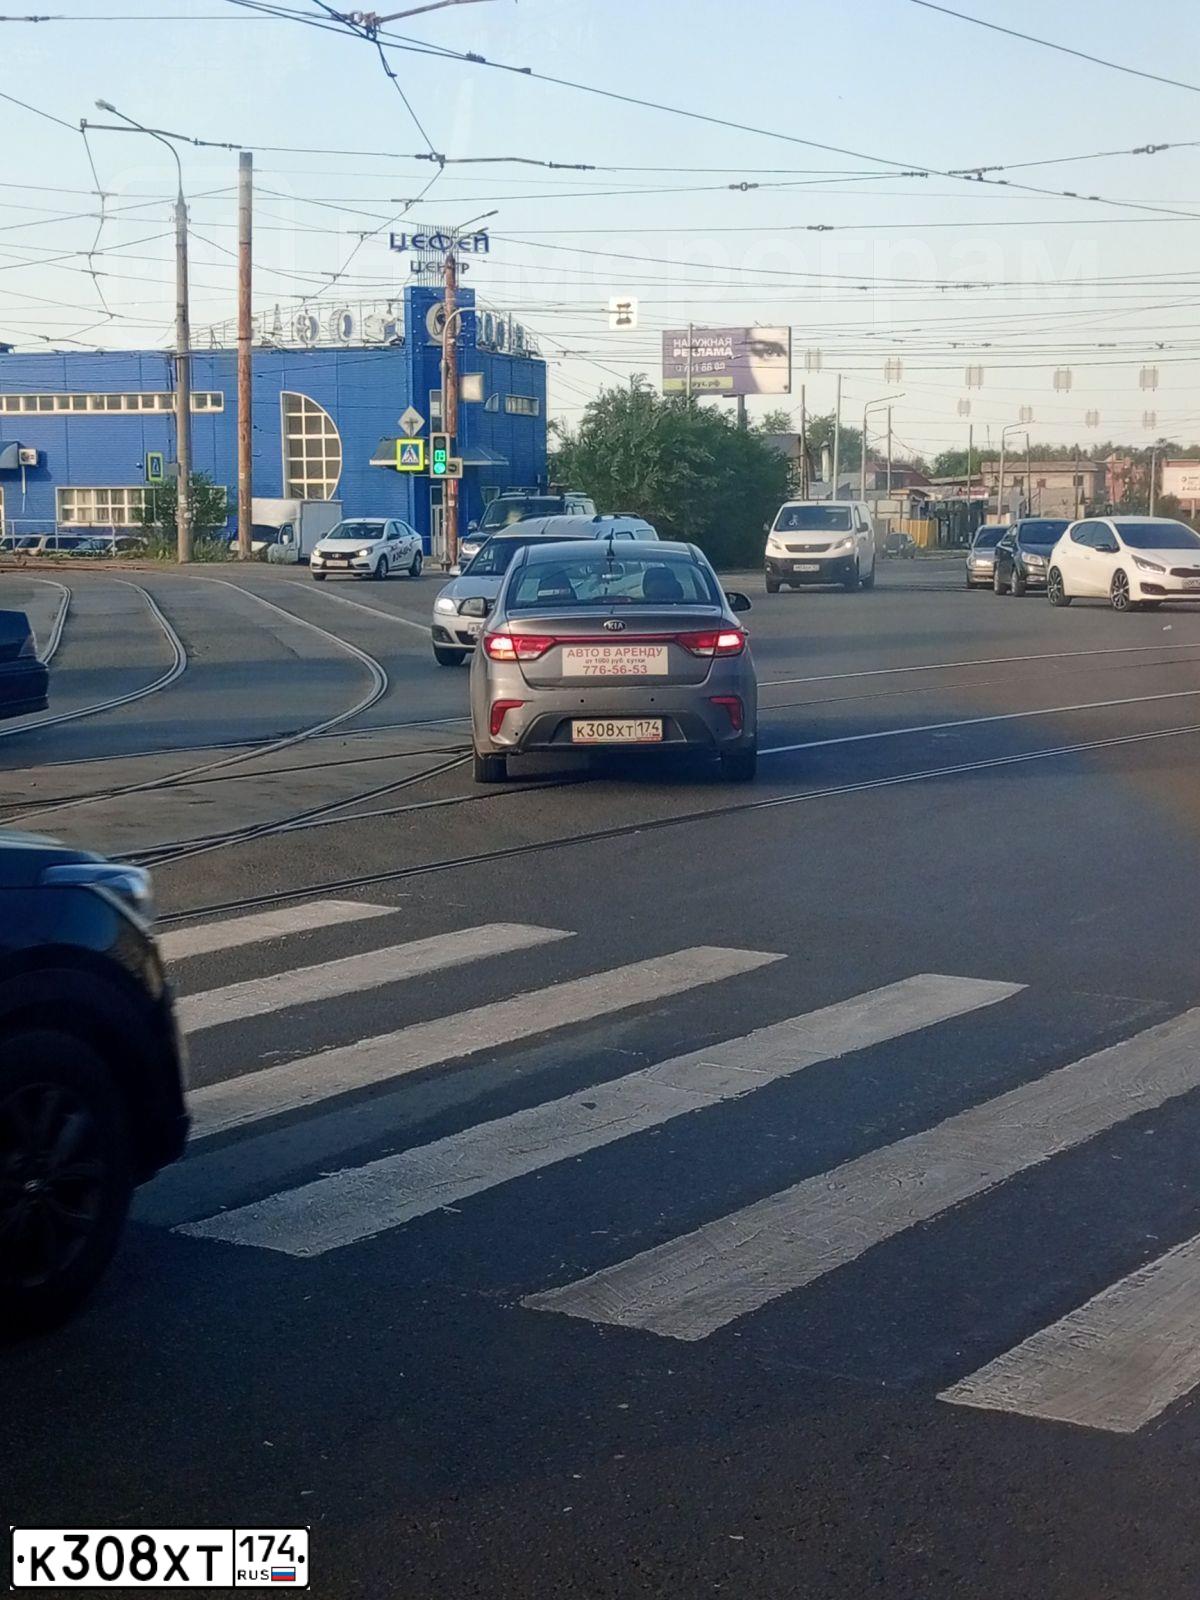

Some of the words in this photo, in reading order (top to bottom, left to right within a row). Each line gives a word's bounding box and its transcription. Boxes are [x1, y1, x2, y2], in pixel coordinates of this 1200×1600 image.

[673, 337, 732, 348] НАРУЖНАЯ
[673, 347, 733, 357] РЕКЛАМА
[606, 622, 624, 630] KIA
[567, 648, 599, 658] АВТО
[603, 648, 611, 657] В
[614, 647, 663, 658] АРЕНДУ
[582, 664, 648, 675] 776-56-53
[576, 723, 633, 737] К308ХТ
[637, 721, 659, 733] 174
